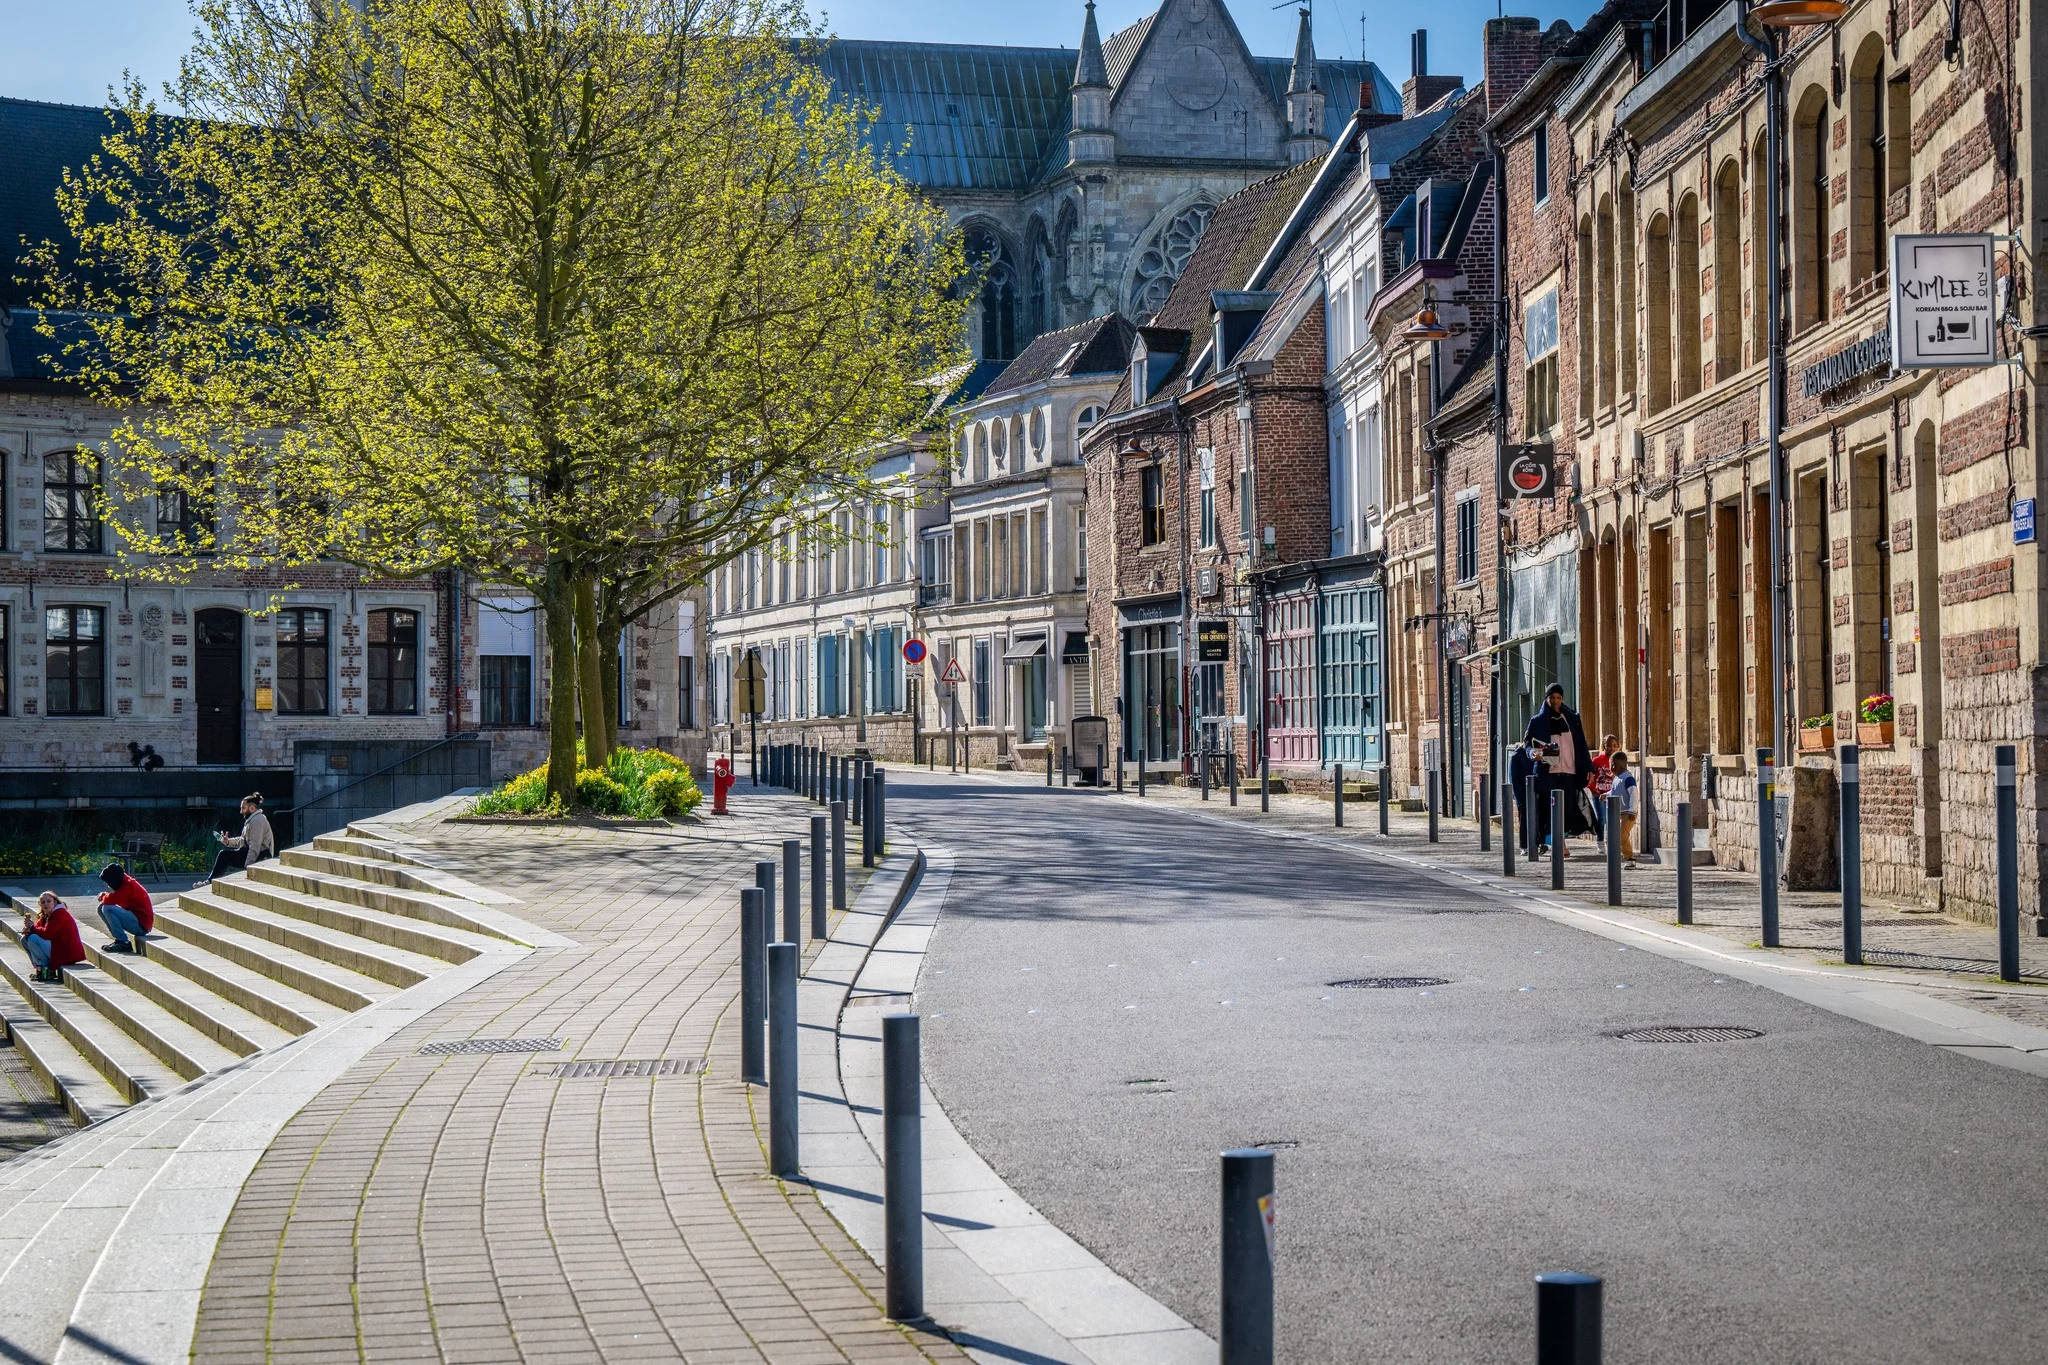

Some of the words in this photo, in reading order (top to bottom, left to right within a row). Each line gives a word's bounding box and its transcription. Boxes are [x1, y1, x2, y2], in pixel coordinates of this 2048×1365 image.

[1900, 275, 1973, 303] KIMLEE
[1977, 271, 1988, 299] 김이
[1802, 343, 1859, 398] RESTAURANT
